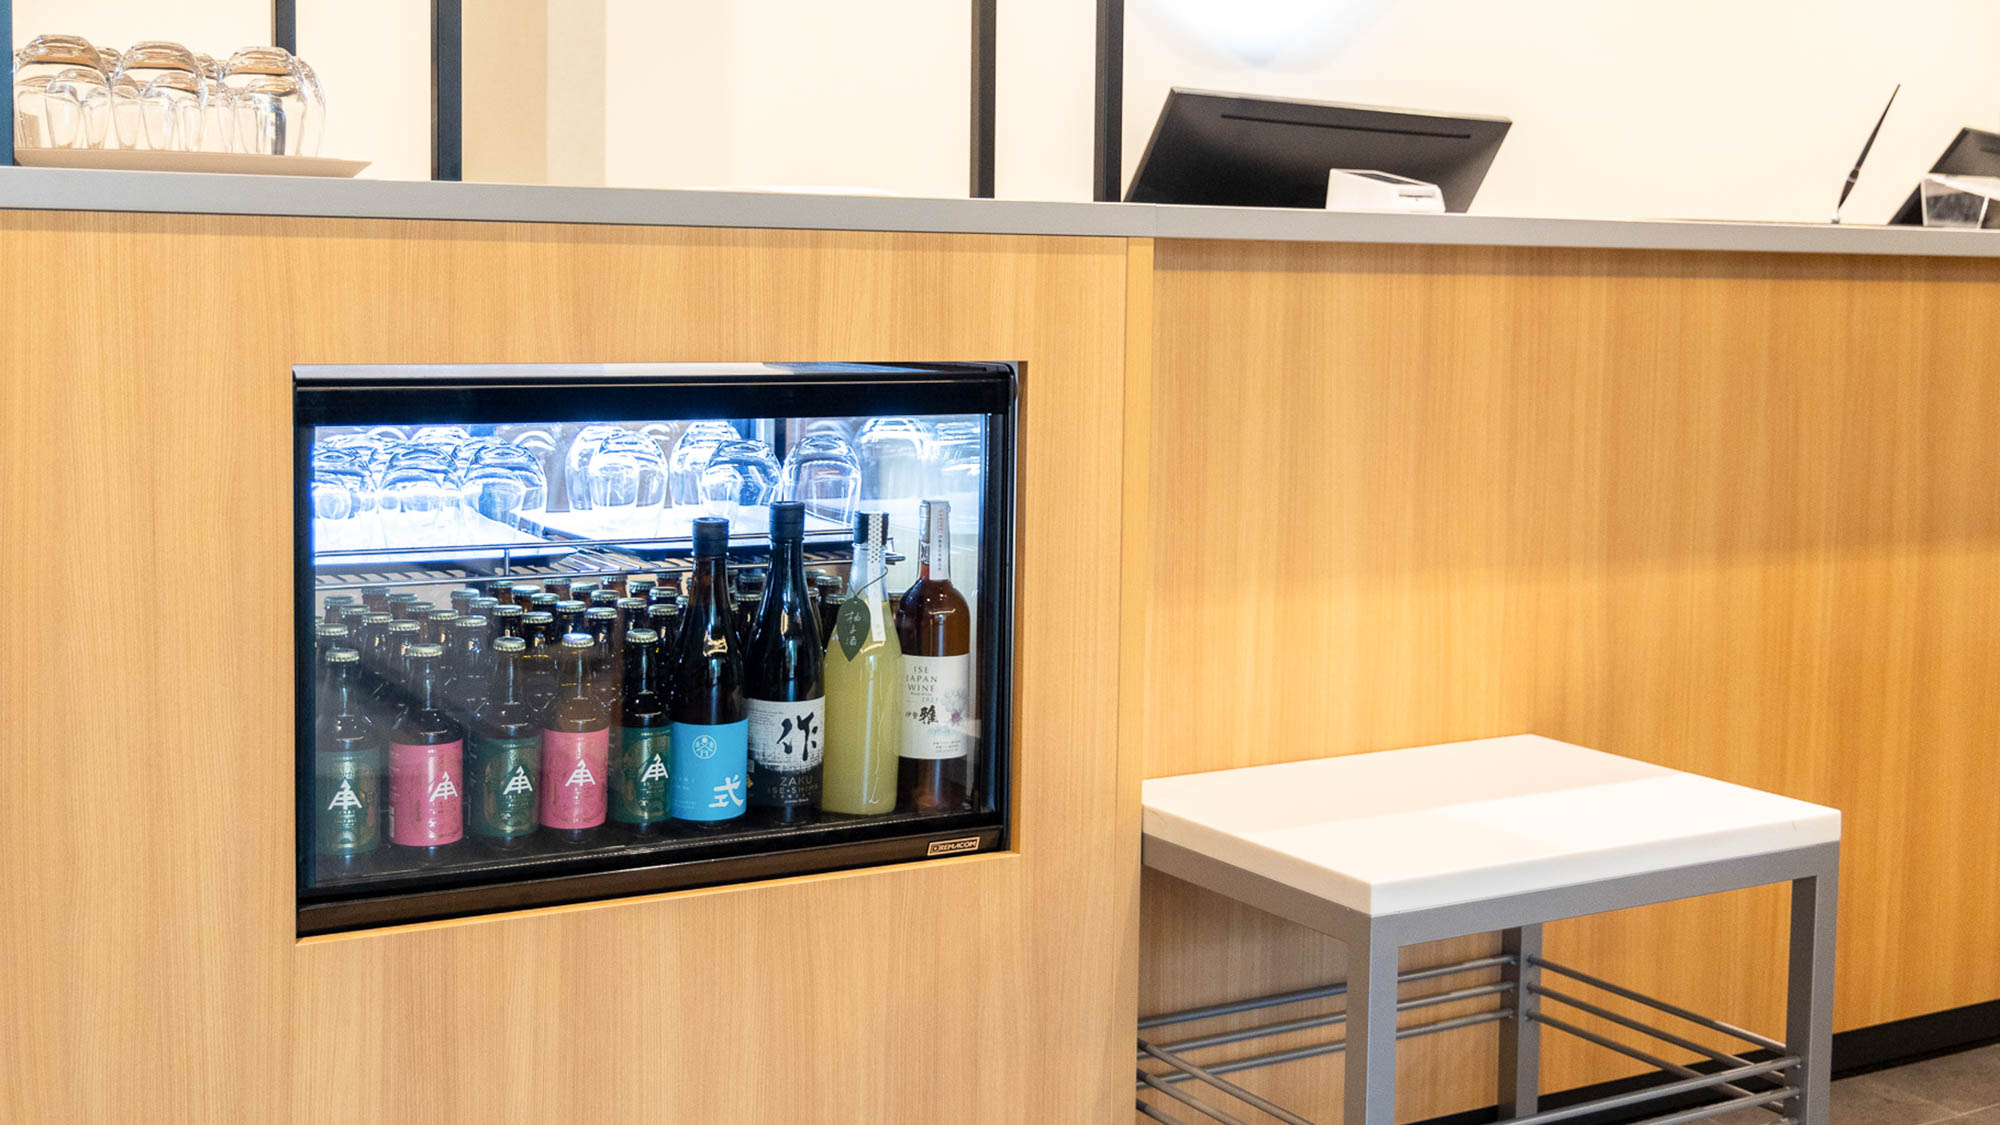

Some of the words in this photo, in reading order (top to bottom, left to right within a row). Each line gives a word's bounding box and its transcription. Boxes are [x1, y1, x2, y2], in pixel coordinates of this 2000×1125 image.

[914, 666, 928, 674] ISE
[906, 675, 937, 683] JAPAN
[908, 684, 935, 692] WINE
[776, 711, 818, 762] 作
[780, 775, 813, 787] ZAKU
[708, 774, 744, 807] 式
